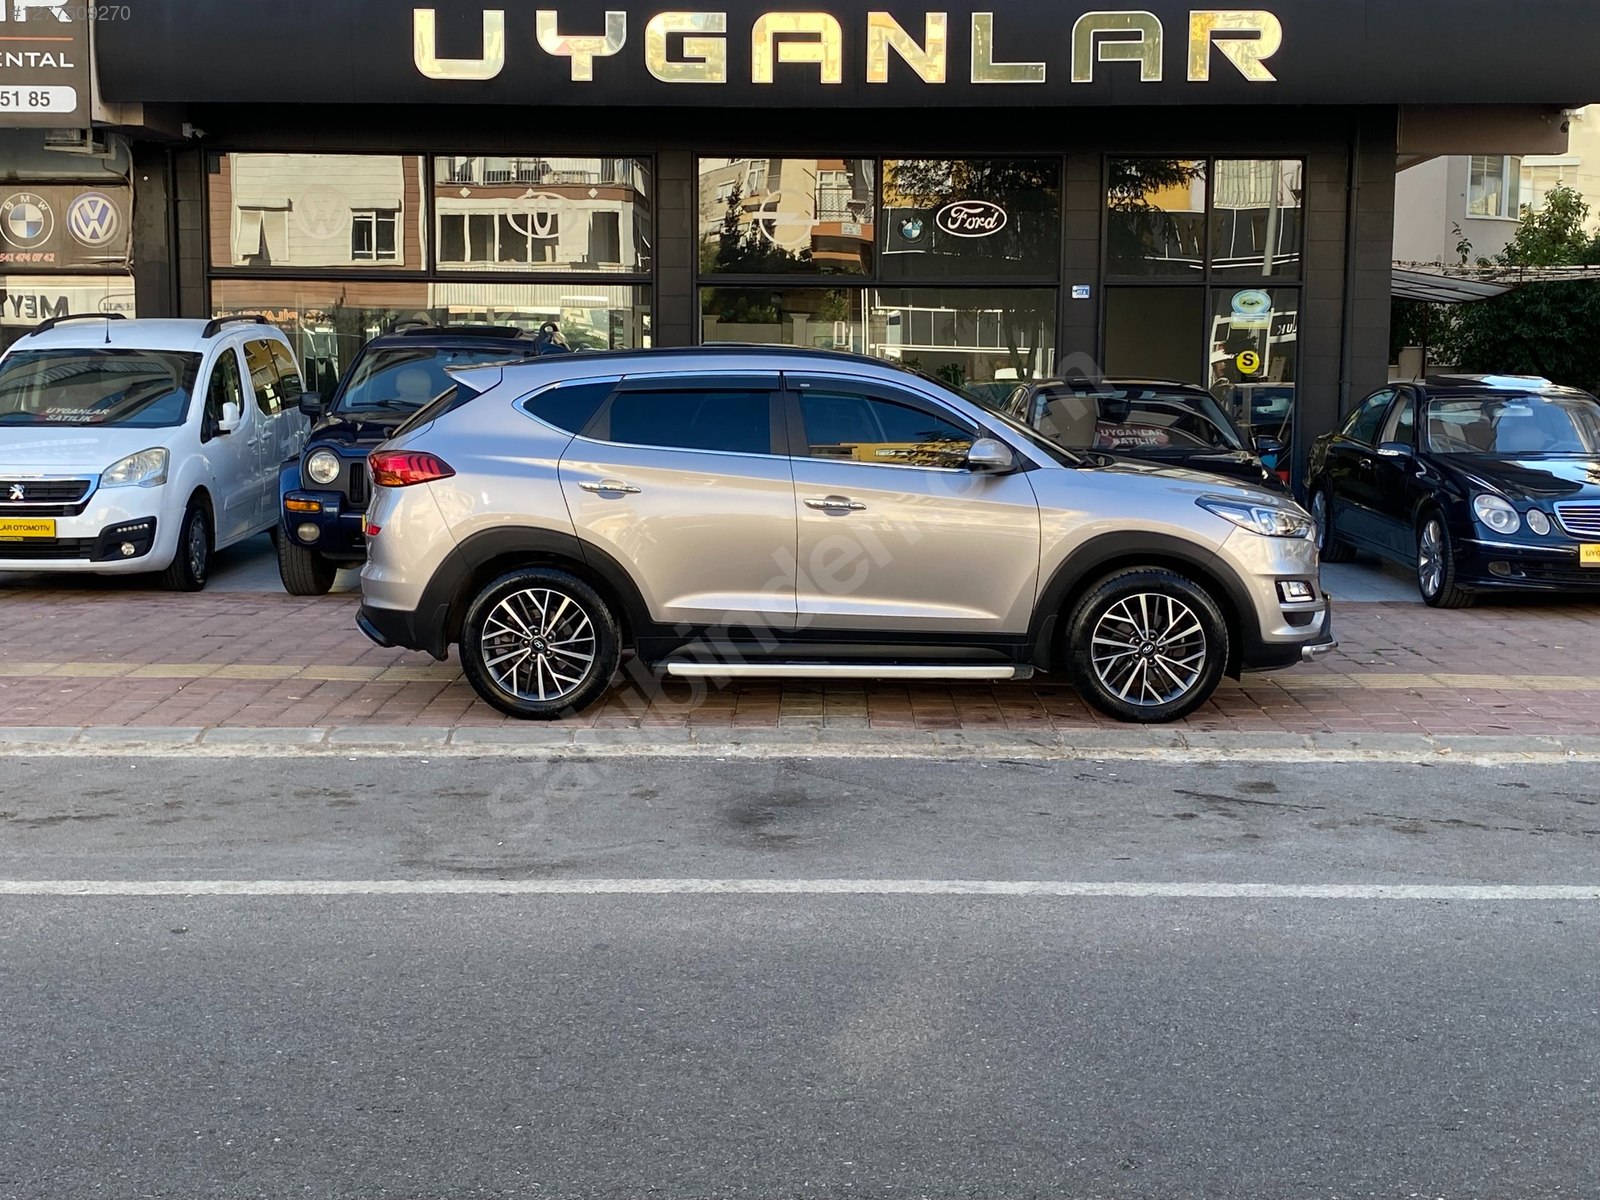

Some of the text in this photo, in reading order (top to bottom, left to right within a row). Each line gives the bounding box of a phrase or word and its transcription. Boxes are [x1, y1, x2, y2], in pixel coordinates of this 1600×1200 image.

[413, 8, 1283, 84] UYGANLAR
[0, 52, 75, 68] NTAL
[29, 91, 50, 107] 85
[947, 206, 999, 230] Ford
[1242, 353, 1254, 366] S
[46, 407, 110, 415] UYGANLAR
[46, 414, 93, 422] SATILIK
[1101, 428, 1165, 437] UYGANLAR
